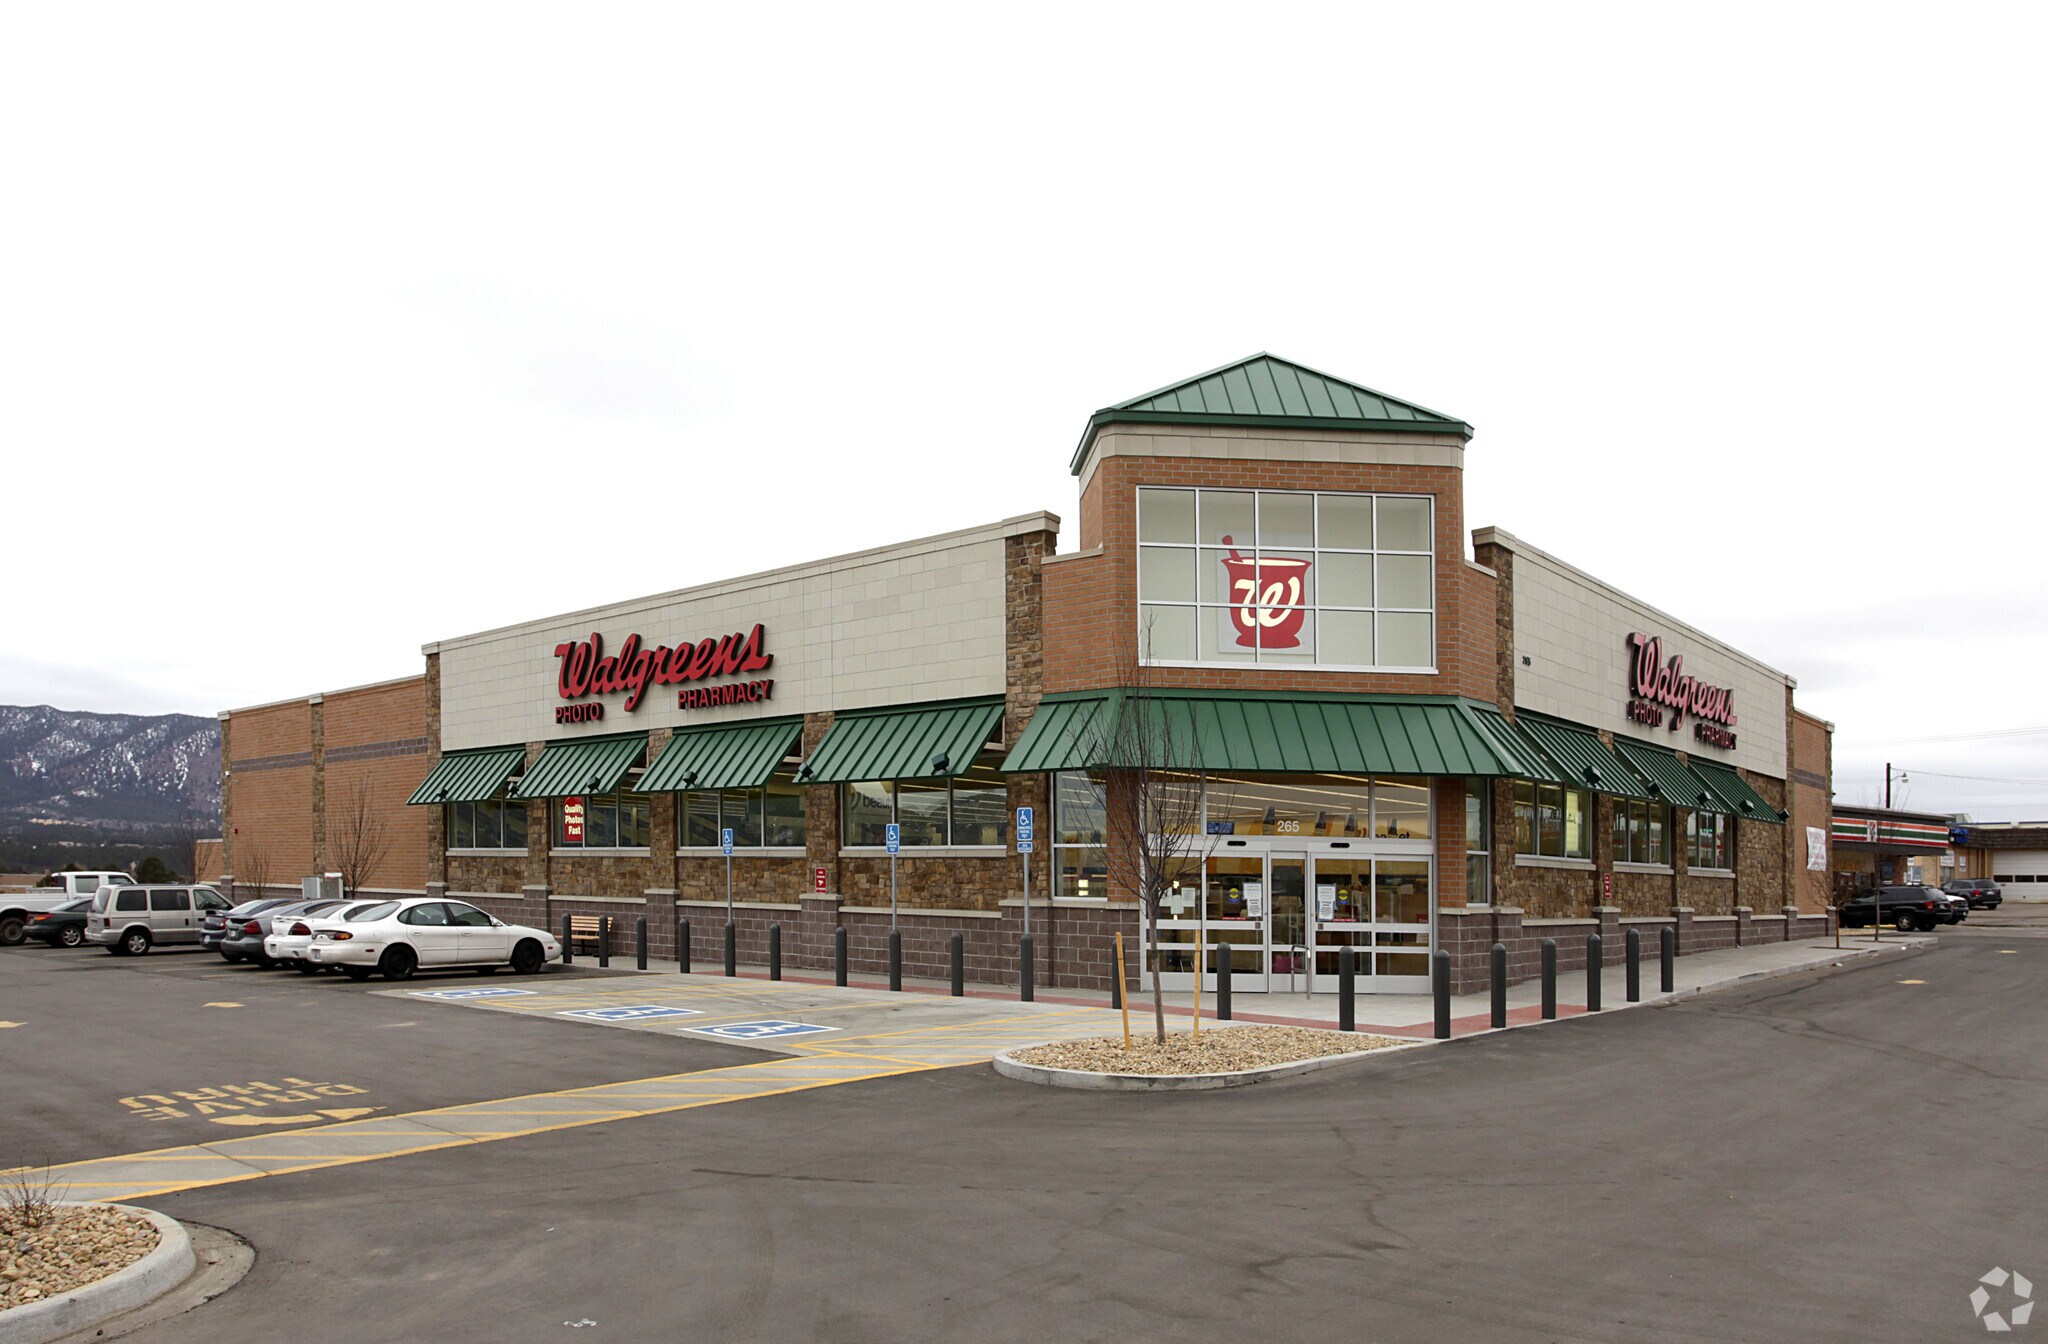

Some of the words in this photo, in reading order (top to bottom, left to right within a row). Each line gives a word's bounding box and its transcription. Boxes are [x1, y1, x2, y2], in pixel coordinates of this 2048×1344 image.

[554, 623, 774, 712] Walgreens
[678, 679, 774, 710] PHARMACY
[1627, 632, 1737, 731] Walgreens
[555, 702, 604, 724] PHOTO
[1631, 700, 1663, 727] PHOTO
[1699, 723, 1737, 750] PHARMACY
[564, 803, 583, 814] Quality
[568, 825, 581, 835] Fast
[1277, 820, 1300, 833] 265
[118, 1077, 331, 1109] THRU
[130, 1084, 370, 1121] DRIVE
